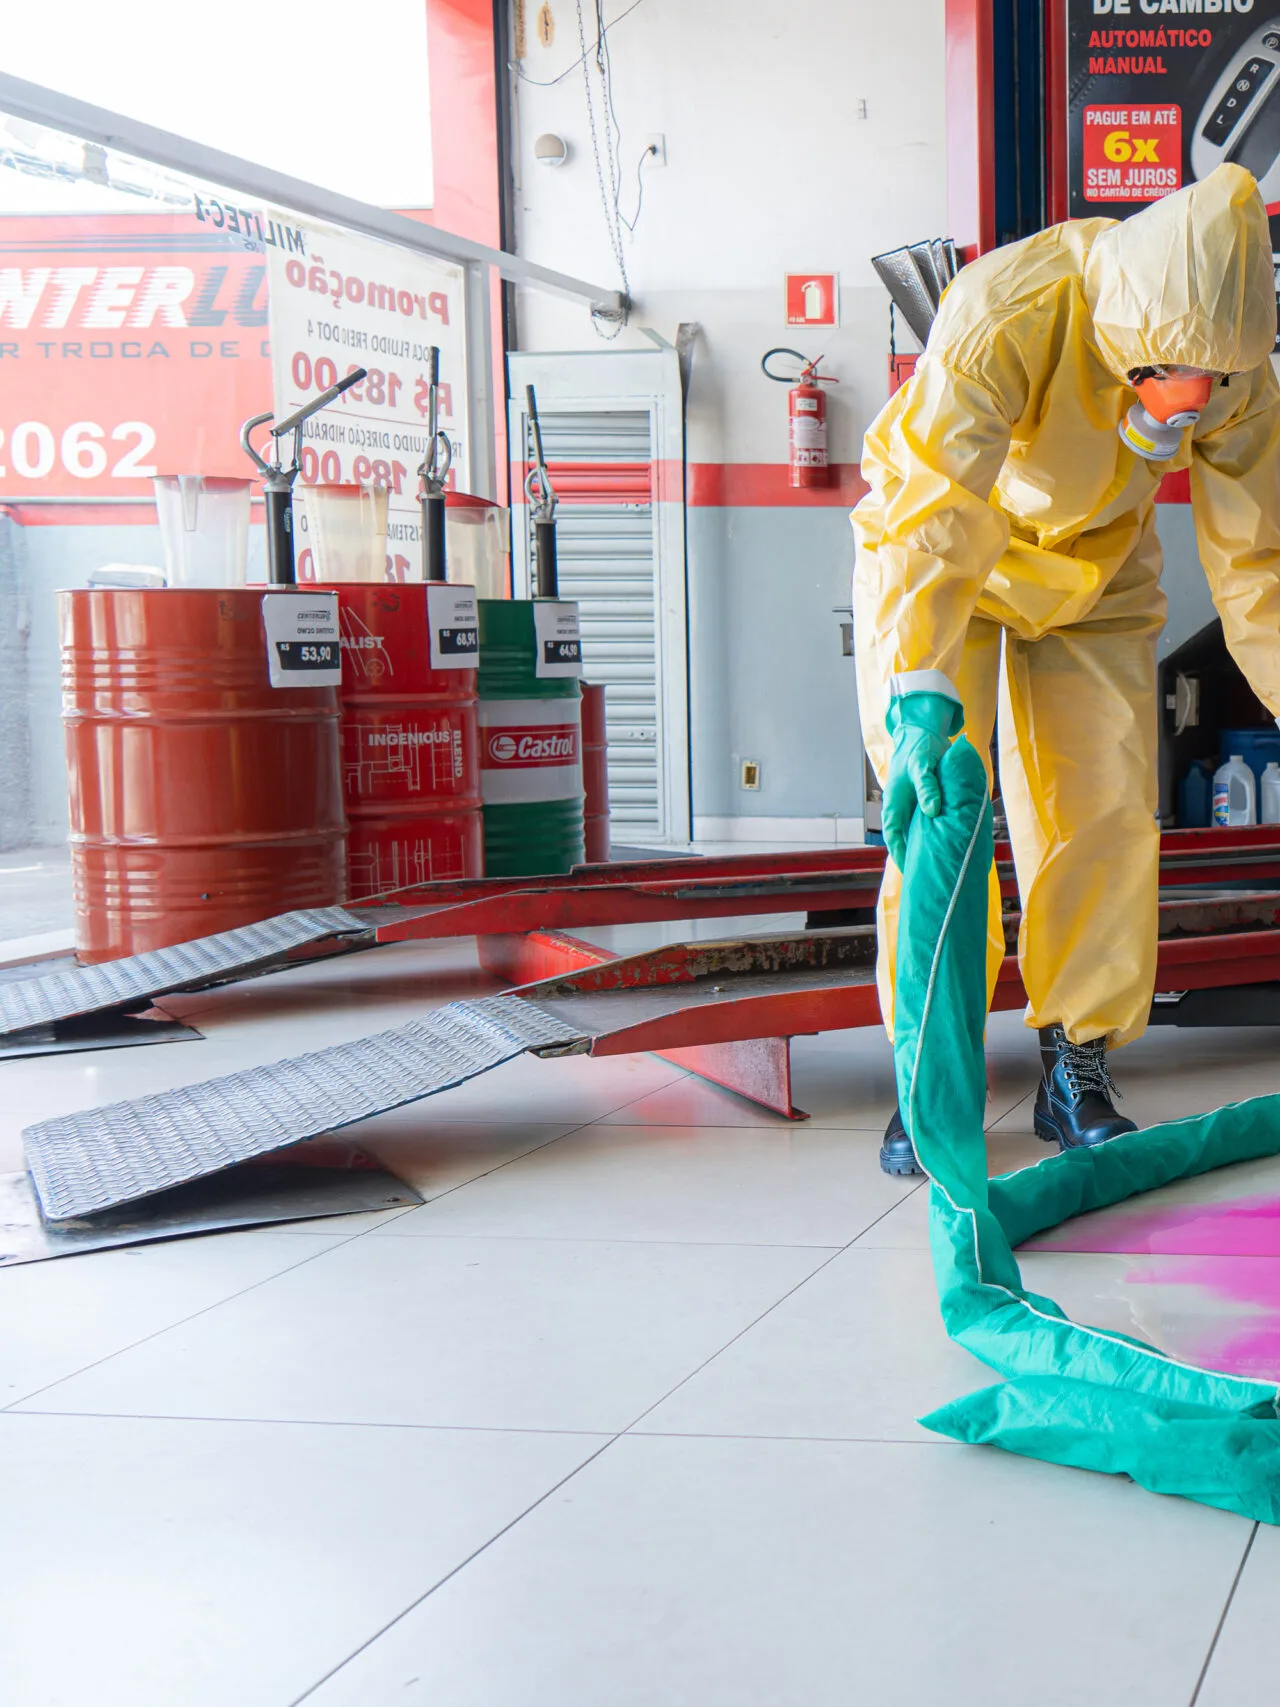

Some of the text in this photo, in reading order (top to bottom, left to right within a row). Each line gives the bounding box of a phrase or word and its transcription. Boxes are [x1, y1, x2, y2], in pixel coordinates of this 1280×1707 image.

[1093, 0, 1131, 15] DE
[1088, 24, 1213, 48] AUTOMÁTICO
[1088, 56, 1167, 75] MANUAL
[1086, 107, 1177, 126] PAGUE EM ATÉ
[1103, 130, 1161, 164] 6x
[1087, 168, 1177, 187] SEM JUROS
[1086, 188, 1099, 198] NO
[1100, 186, 1130, 198] CARTÃO
[1132, 188, 1143, 198] DE
[36, 341, 170, 358] TROCA
[189, 341, 240, 358] DE
[0, 421, 157, 478] 062
[301, 646, 331, 663] 53,90
[368, 730, 450, 747] INGENIOUS
[518, 735, 574, 758] Castrol
[453, 730, 463, 777] BLEND
